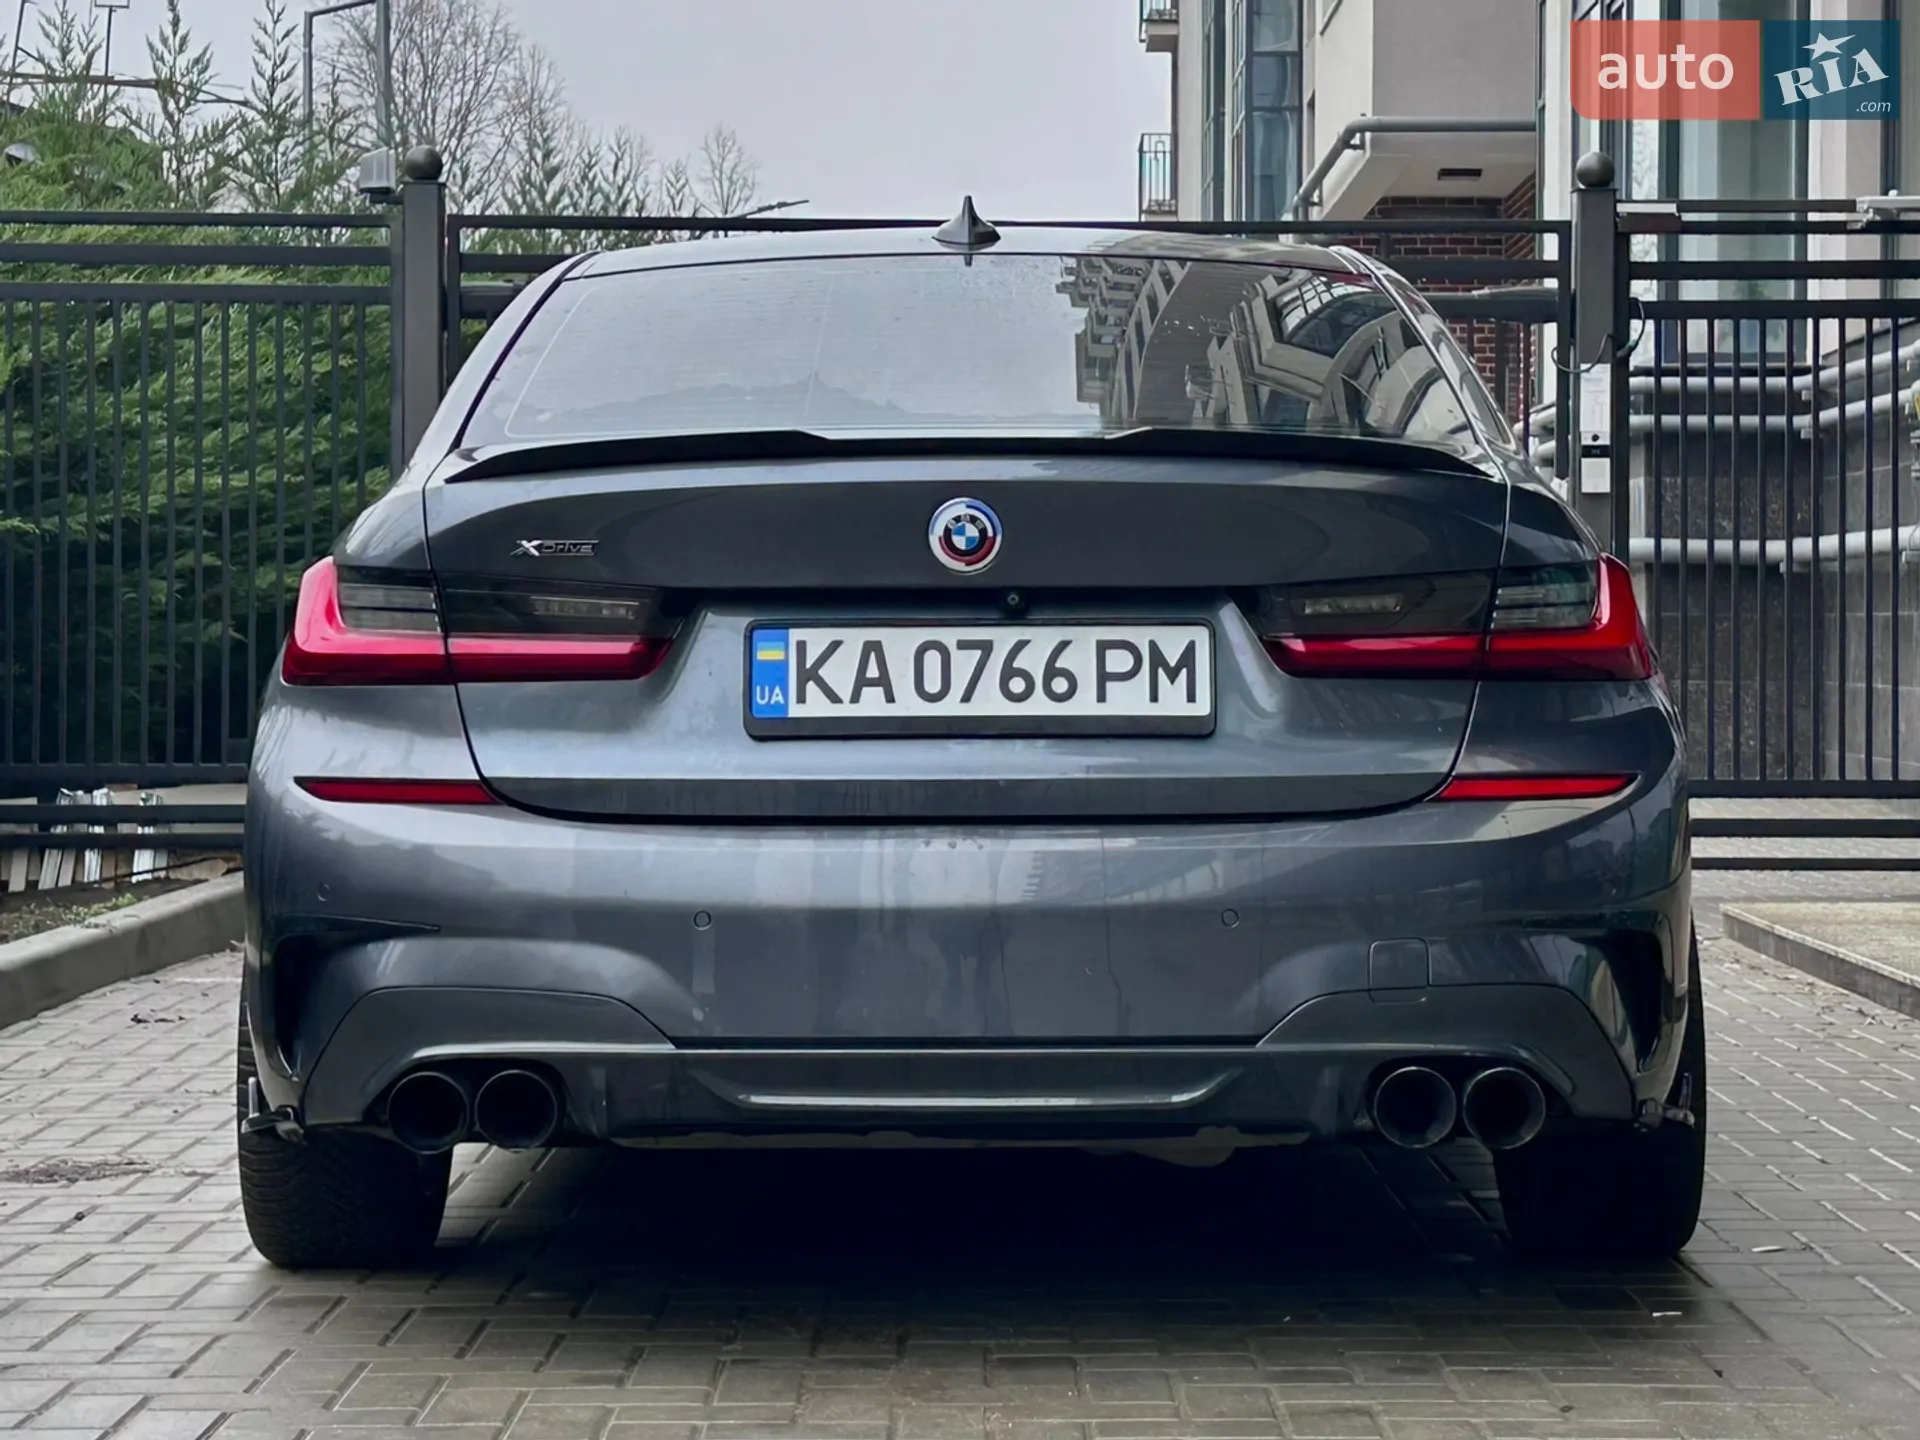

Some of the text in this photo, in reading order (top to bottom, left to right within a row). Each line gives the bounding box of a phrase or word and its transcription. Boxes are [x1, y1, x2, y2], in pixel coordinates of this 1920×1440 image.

[795, 639, 1197, 705] KA 0766 PM
[756, 685, 785, 705] UA
